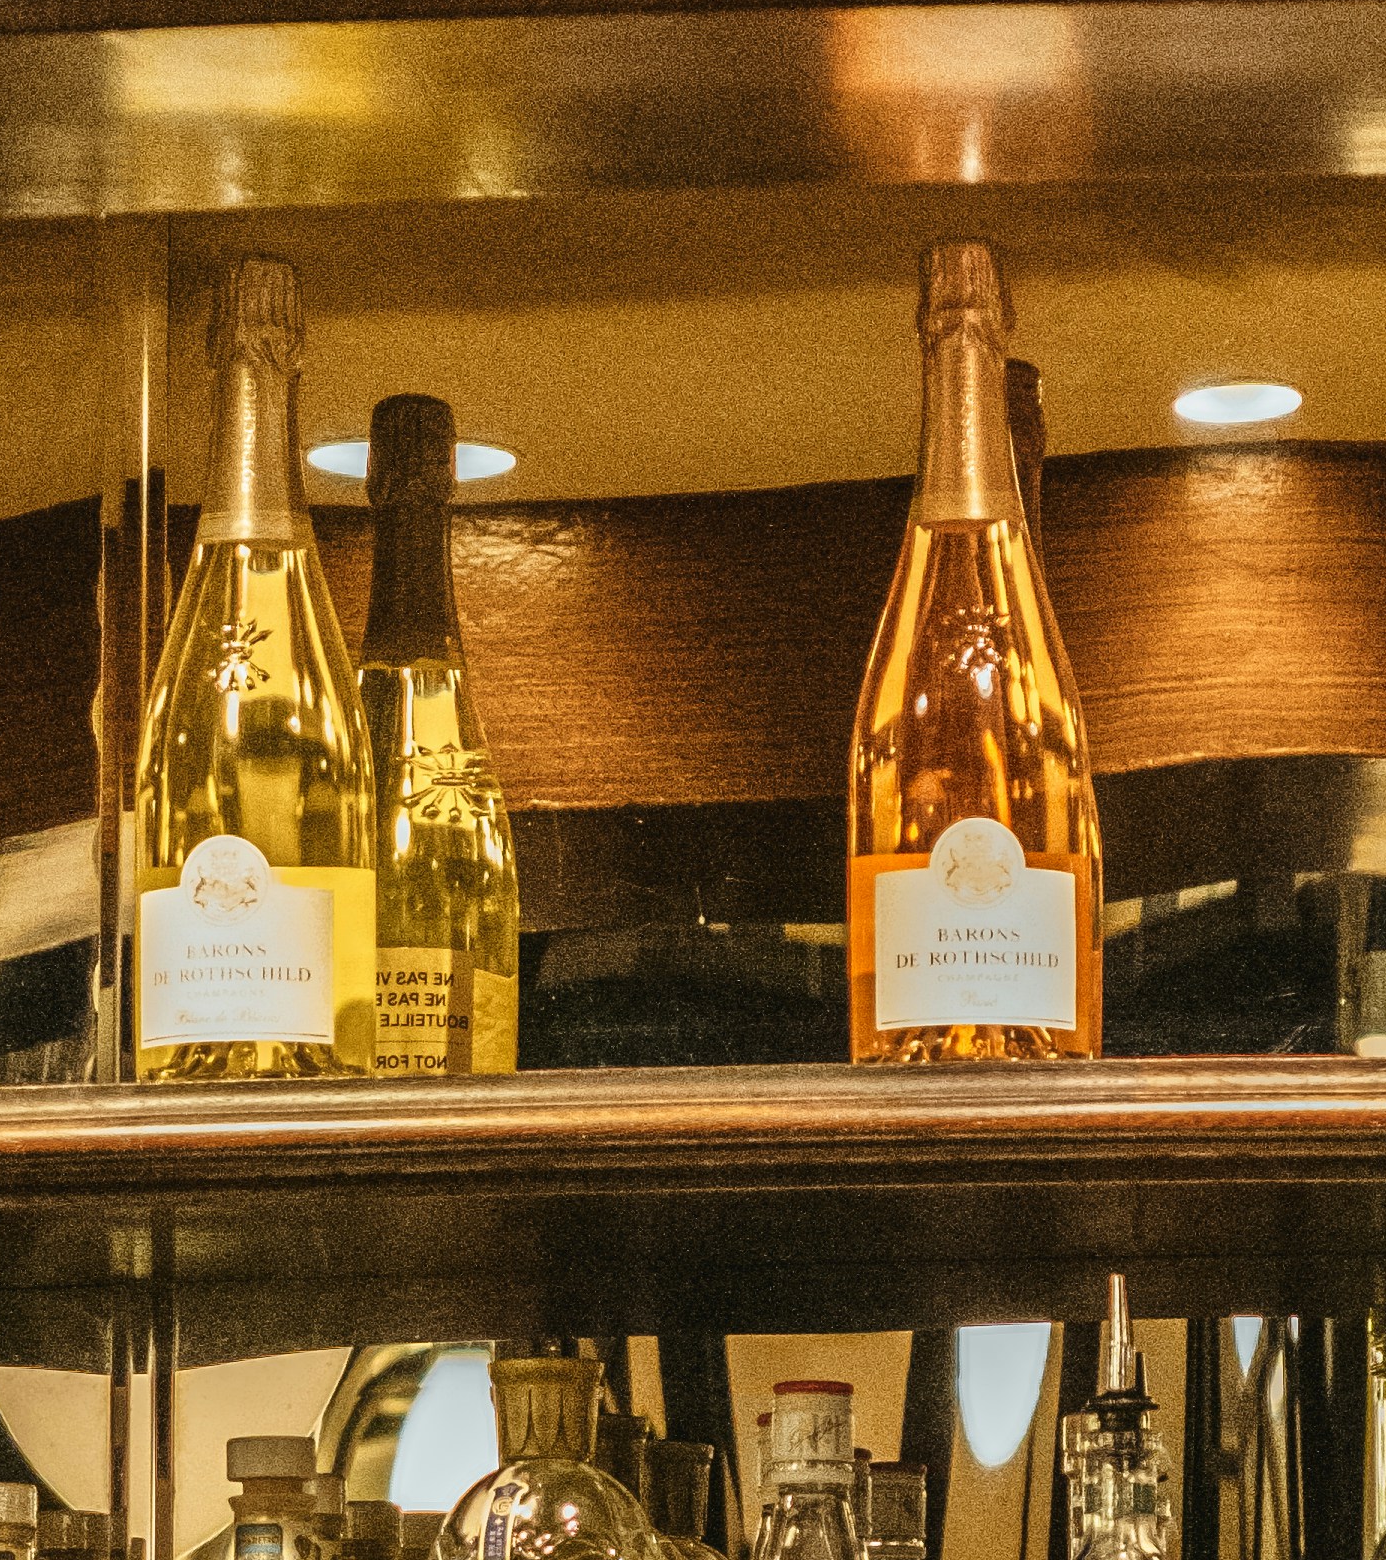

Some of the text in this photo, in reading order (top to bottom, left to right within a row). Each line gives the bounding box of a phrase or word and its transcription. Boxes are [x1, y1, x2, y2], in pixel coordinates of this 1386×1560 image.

[937, 928, 1021, 942] BARONS
[187, 943, 267, 959] BARONS
[896, 950, 1059, 969] DE ROTHSCHILD
[154, 966, 311, 986] DE ROTHSCHILD
